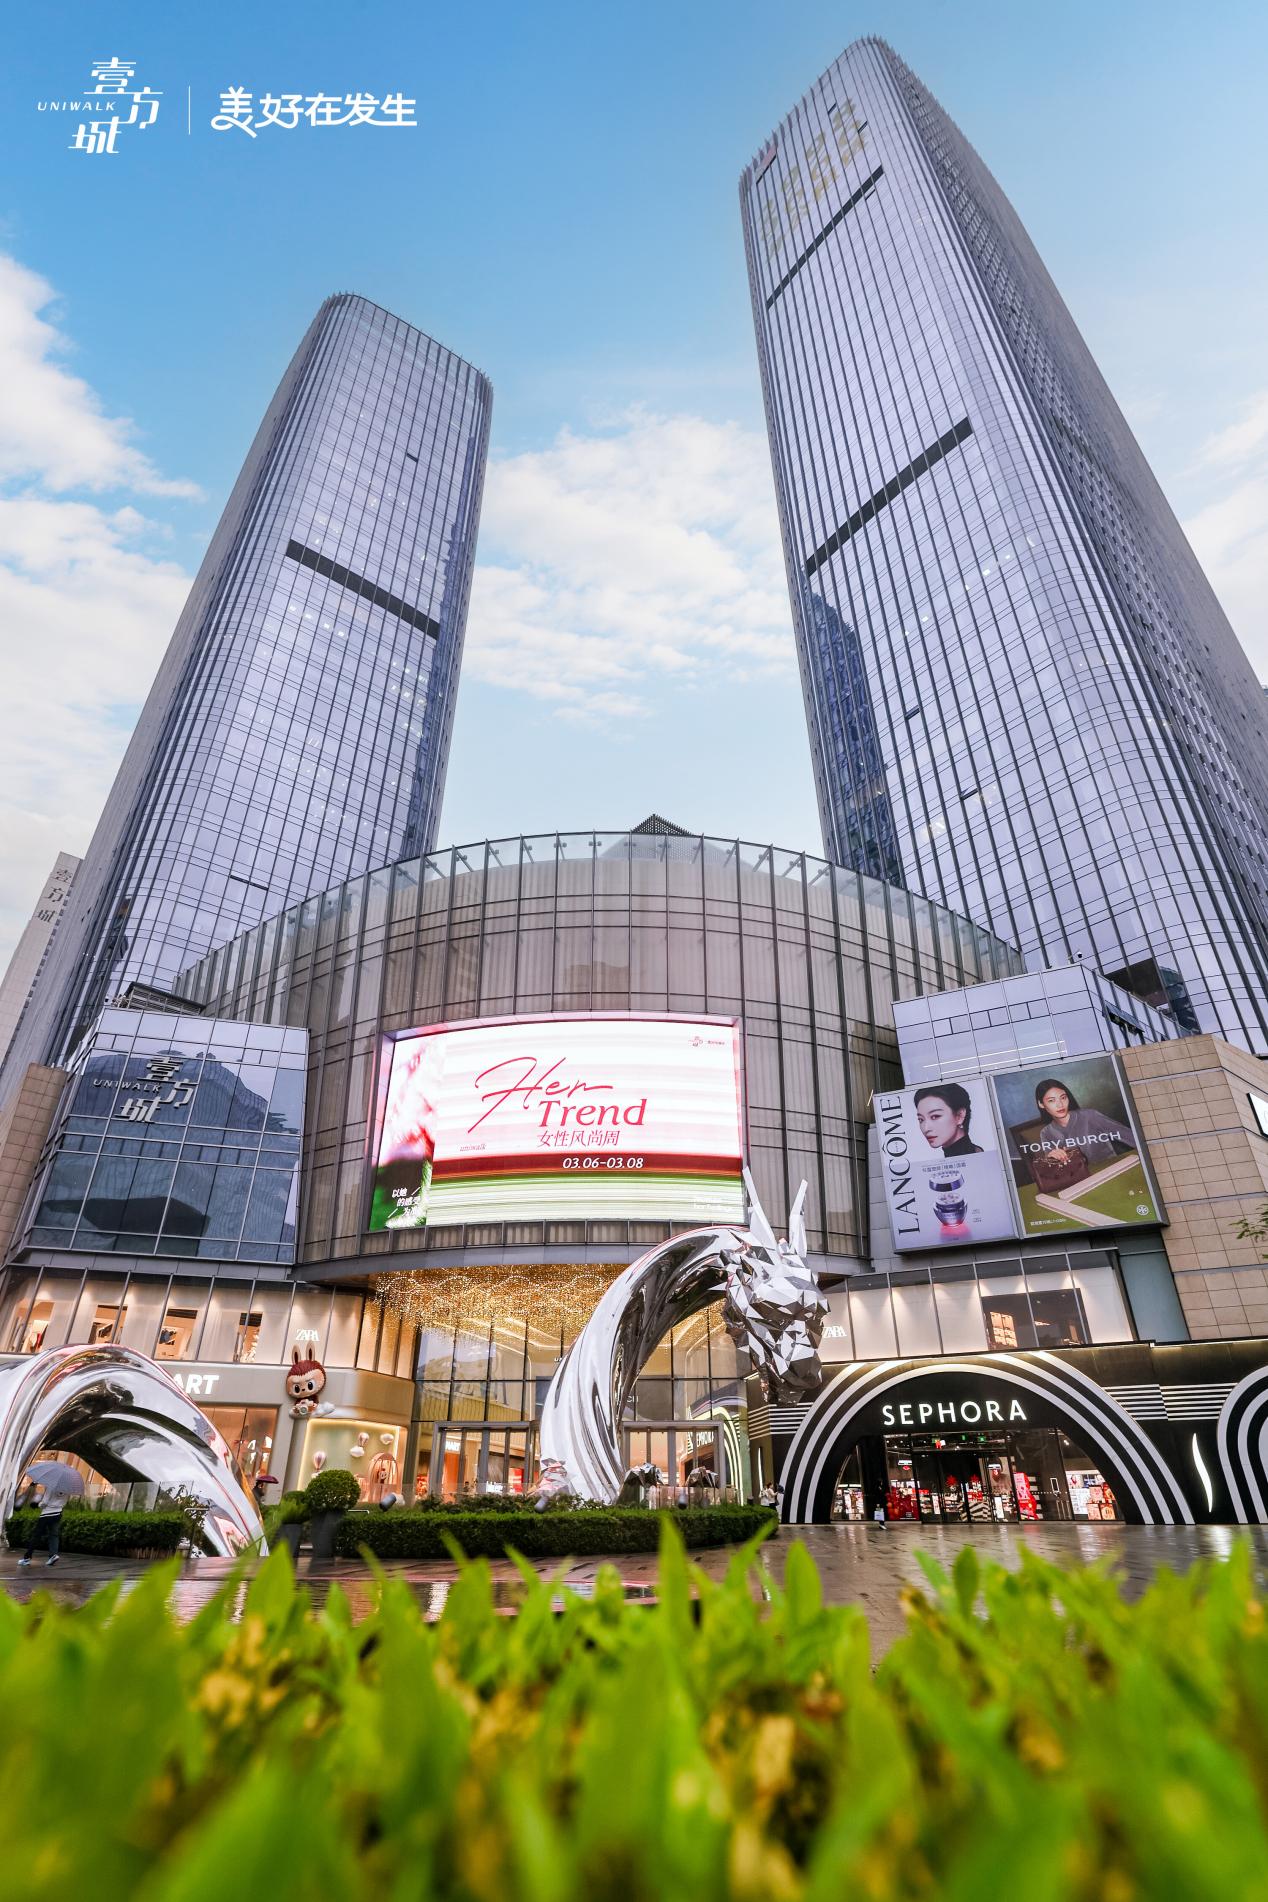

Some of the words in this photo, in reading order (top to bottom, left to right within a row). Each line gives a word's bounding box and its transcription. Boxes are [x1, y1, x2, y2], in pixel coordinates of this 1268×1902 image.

[93, 1078, 162, 1092] UNIWALK
[114, 1056, 200, 1123] 壹方城
[467, 1056, 613, 1134] Her
[538, 1097, 649, 1128] Trend
[536, 1130, 620, 1148] 女性风尚周
[1020, 1138, 1063, 1154] TORY
[1064, 1130, 1122, 1148] BURCH
[562, 1156, 645, 1170] 03.06-03.08
[880, 1095, 920, 1236] LANCÔME
[295, 1328, 319, 1341] ZARA
[882, 1399, 1027, 1426] SEPHORA
